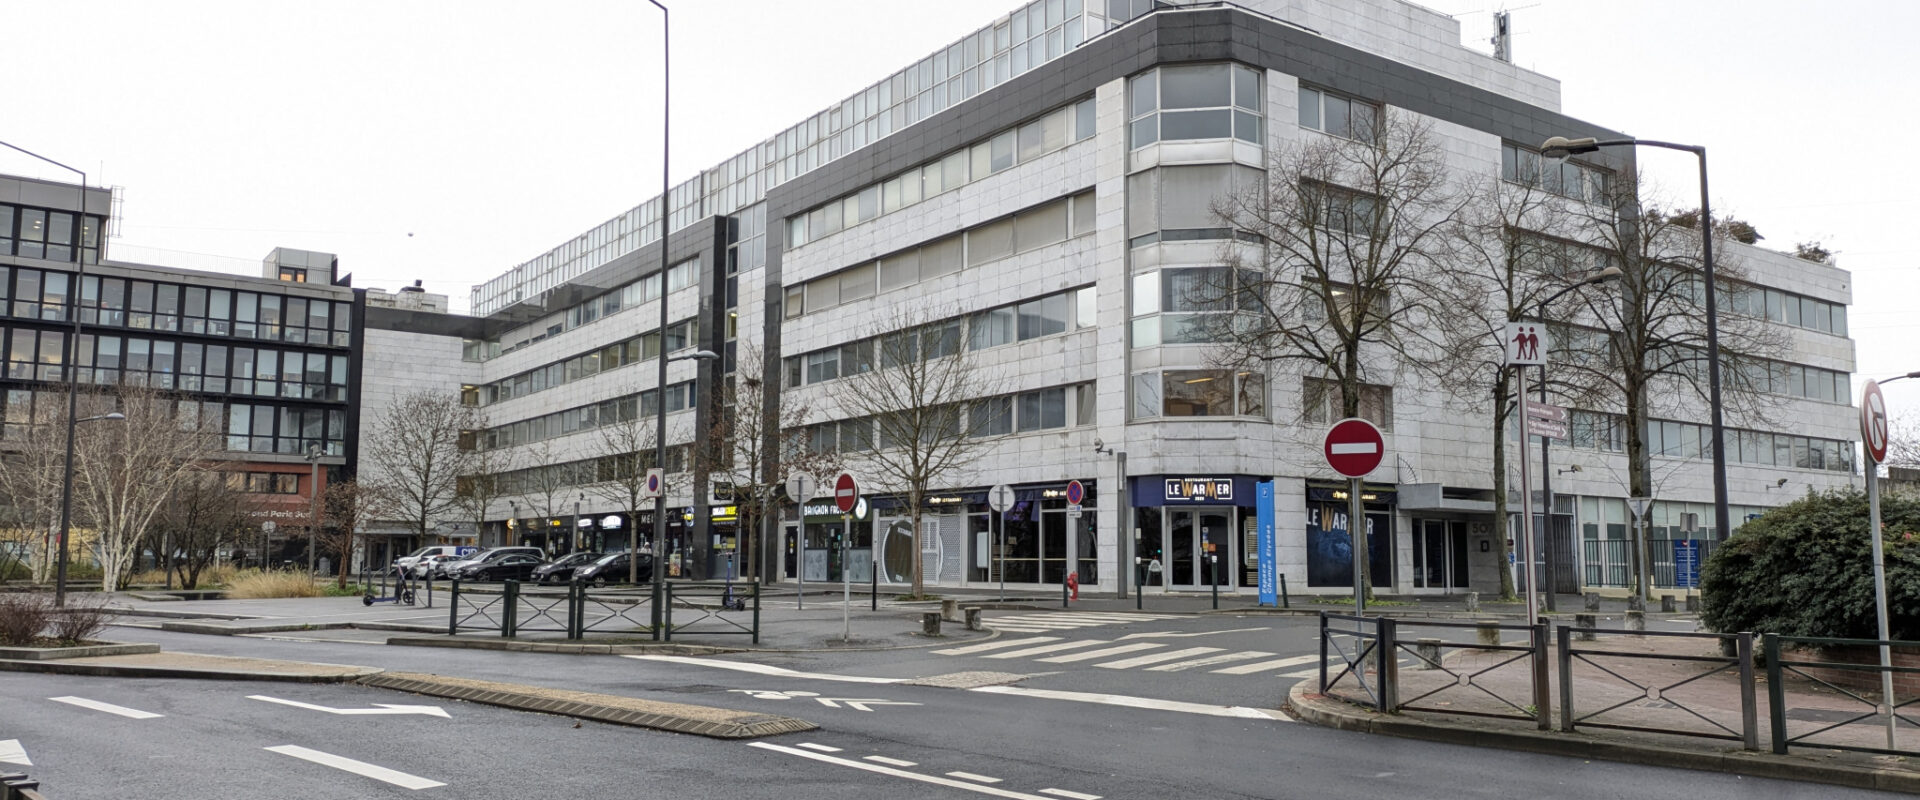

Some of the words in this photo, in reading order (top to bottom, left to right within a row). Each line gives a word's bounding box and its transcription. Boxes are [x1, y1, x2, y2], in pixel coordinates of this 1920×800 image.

[1168, 483, 1180, 495] LE
[1181, 479, 1230, 500] WARMER
[803, 504, 829, 517] BANGKOK
[829, 504, 846, 515] FAC
[1305, 507, 1319, 526] LE
[1321, 501, 1375, 535] WARR
